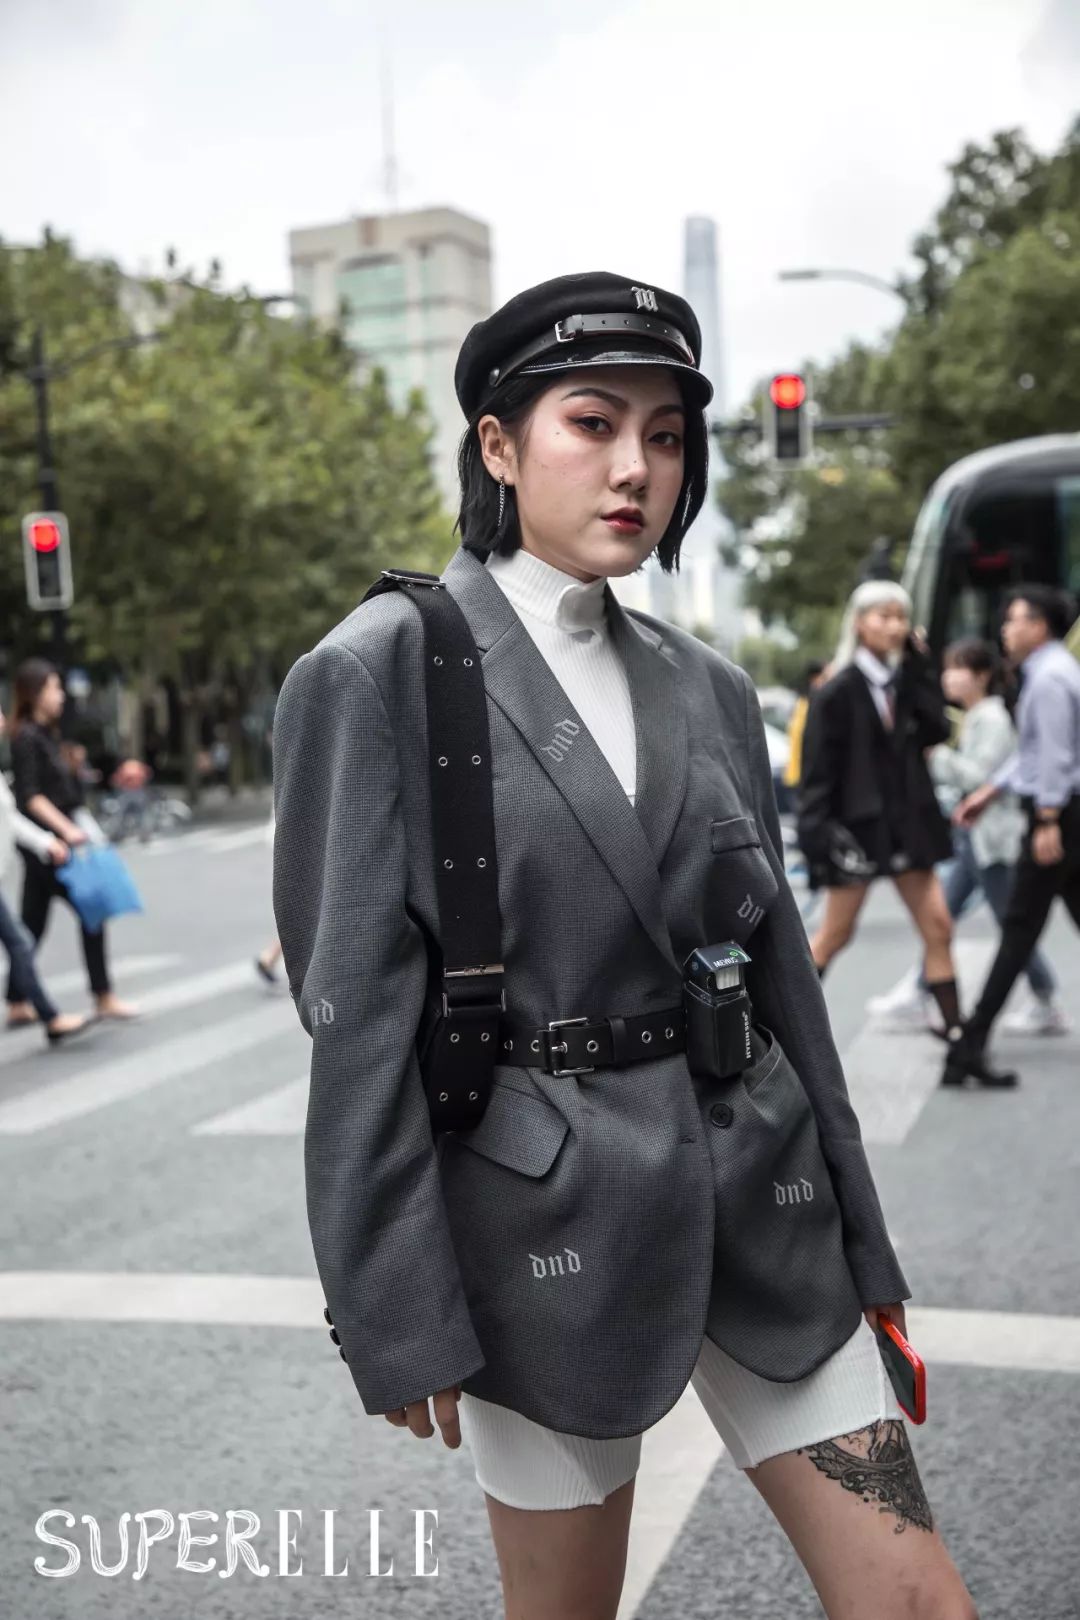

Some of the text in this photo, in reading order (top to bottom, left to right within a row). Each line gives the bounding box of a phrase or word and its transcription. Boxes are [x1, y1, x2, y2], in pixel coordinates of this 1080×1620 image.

[737, 894, 765, 927] dn
[773, 1177, 813, 1205] dnd
[528, 1247, 581, 1278] dnd
